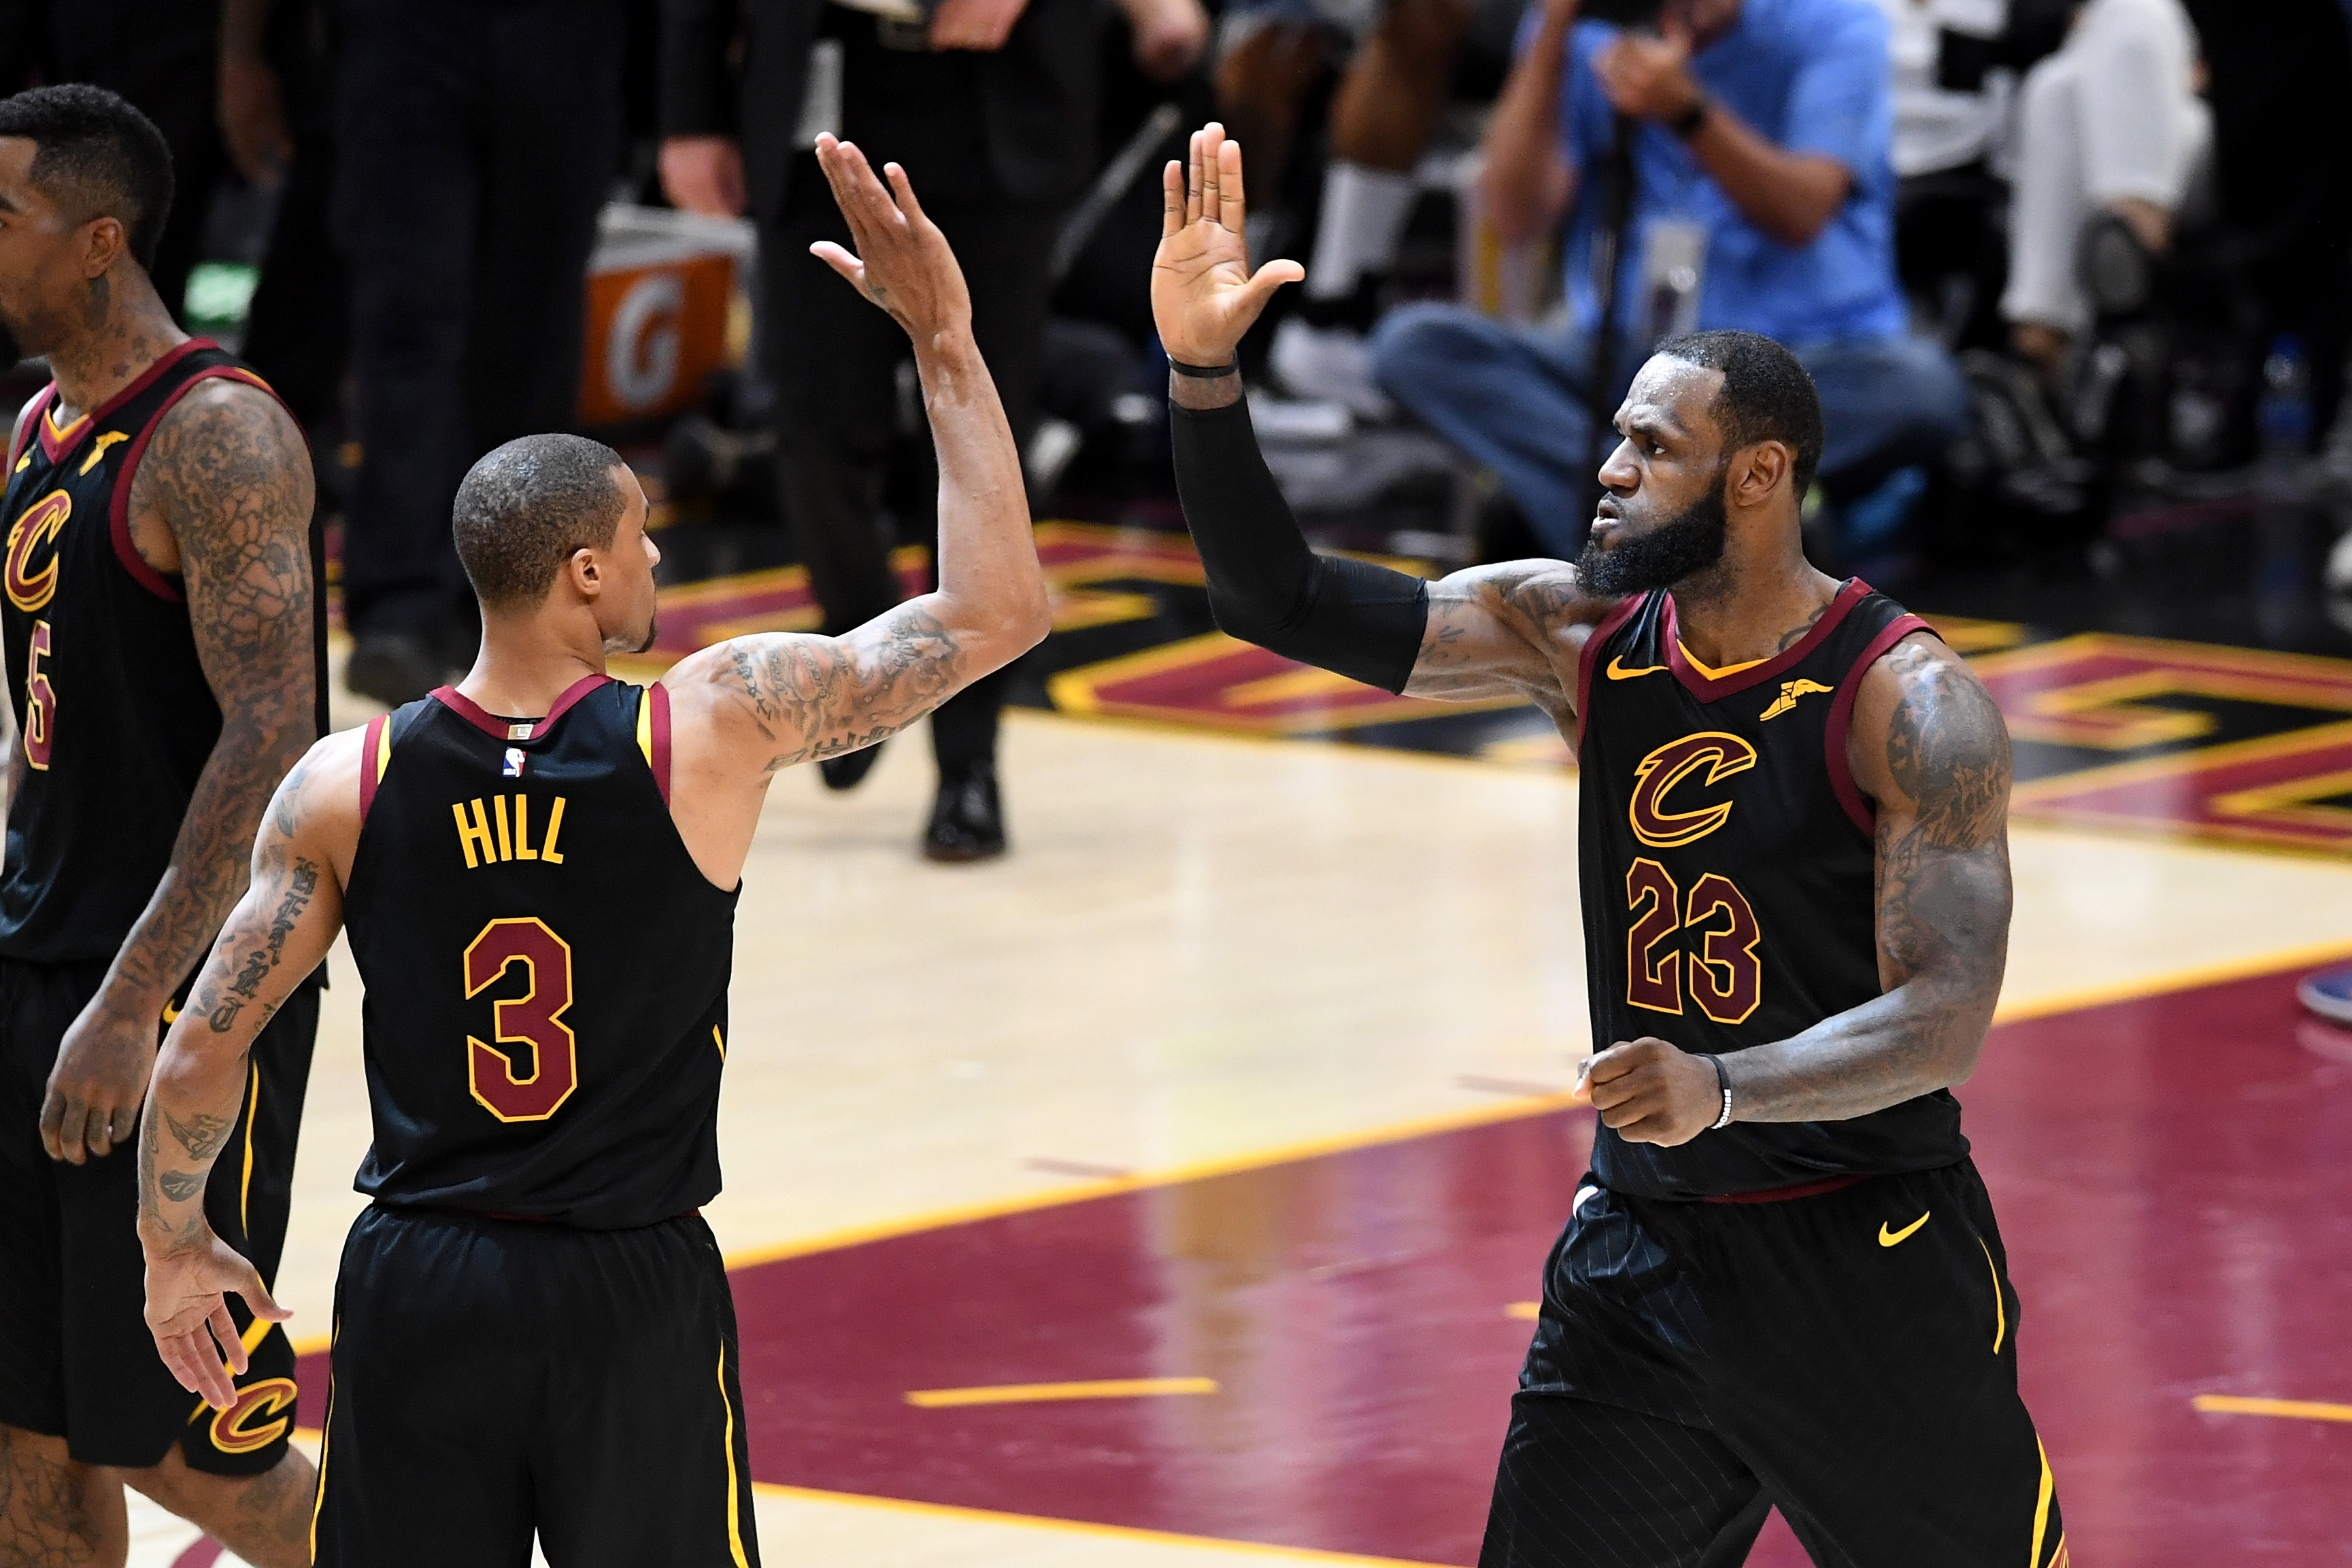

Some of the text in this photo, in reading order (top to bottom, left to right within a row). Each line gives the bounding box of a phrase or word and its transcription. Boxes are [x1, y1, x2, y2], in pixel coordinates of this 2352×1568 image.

[607, 275, 682, 407] G
[4, 488, 72, 612] C
[452, 794, 566, 869] HILL
[1629, 731, 1758, 848] C
[1626, 857, 1761, 1025] 23
[463, 916, 577, 1123] 3
[209, 1376, 298, 1454] C
